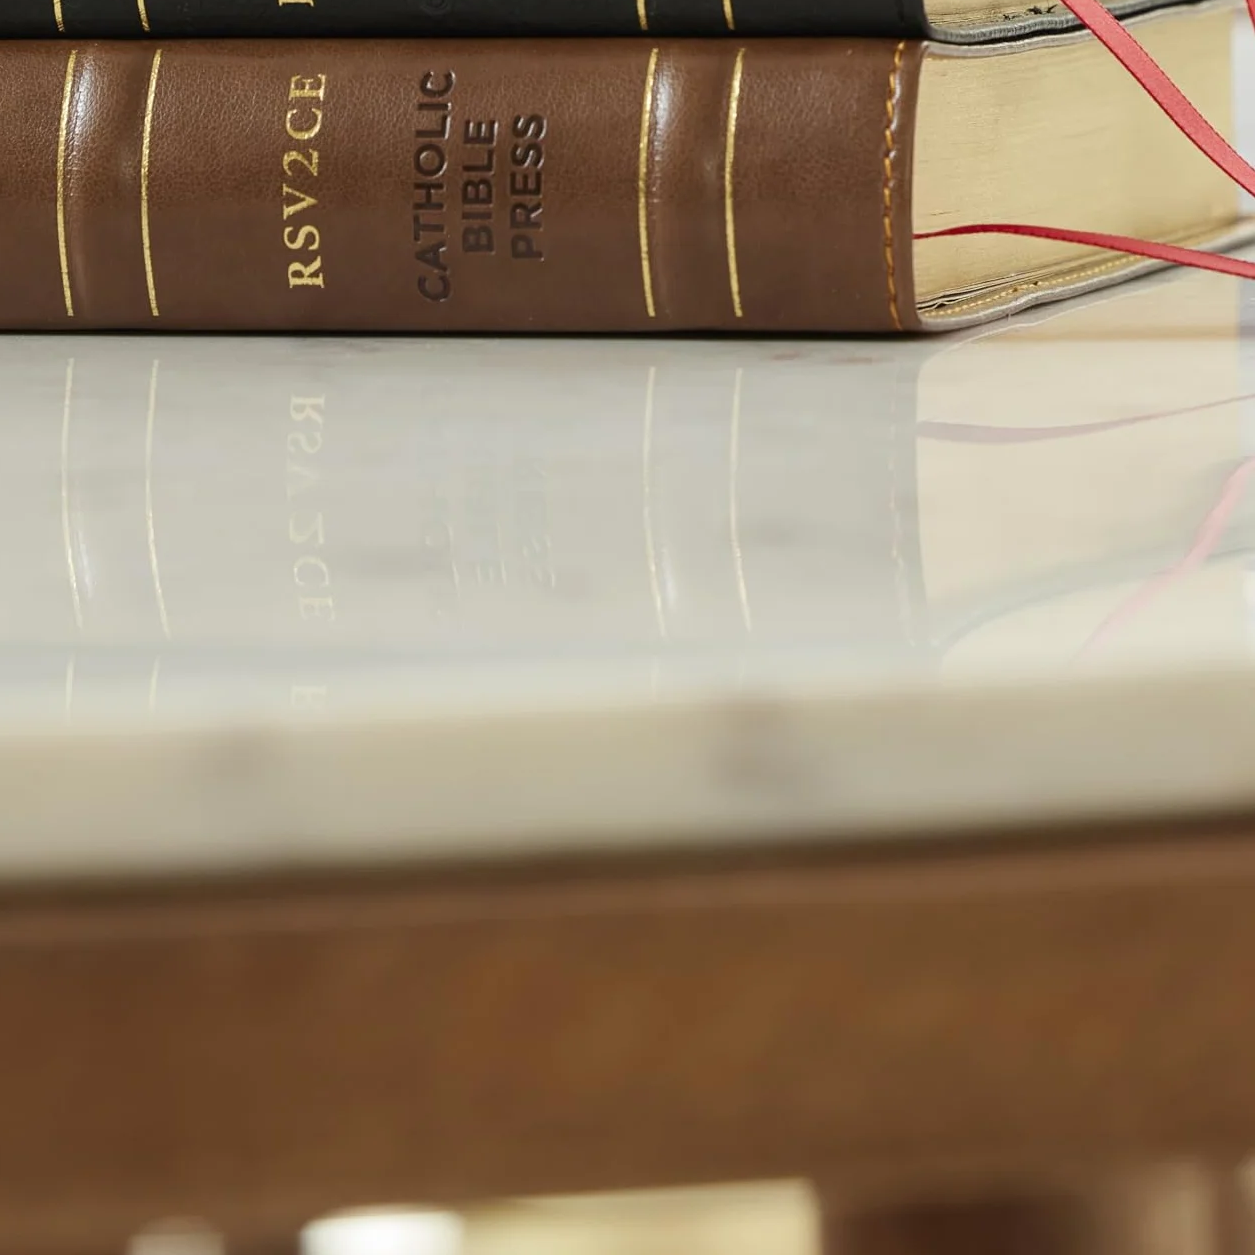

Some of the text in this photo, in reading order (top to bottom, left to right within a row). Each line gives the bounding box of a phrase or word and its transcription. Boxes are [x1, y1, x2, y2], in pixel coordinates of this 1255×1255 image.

[282, 73, 327, 289] RSV2CE
[412, 69, 456, 302] CATHOLIC
[462, 118, 498, 256] BIBLE
[510, 113, 547, 262] PRESS
